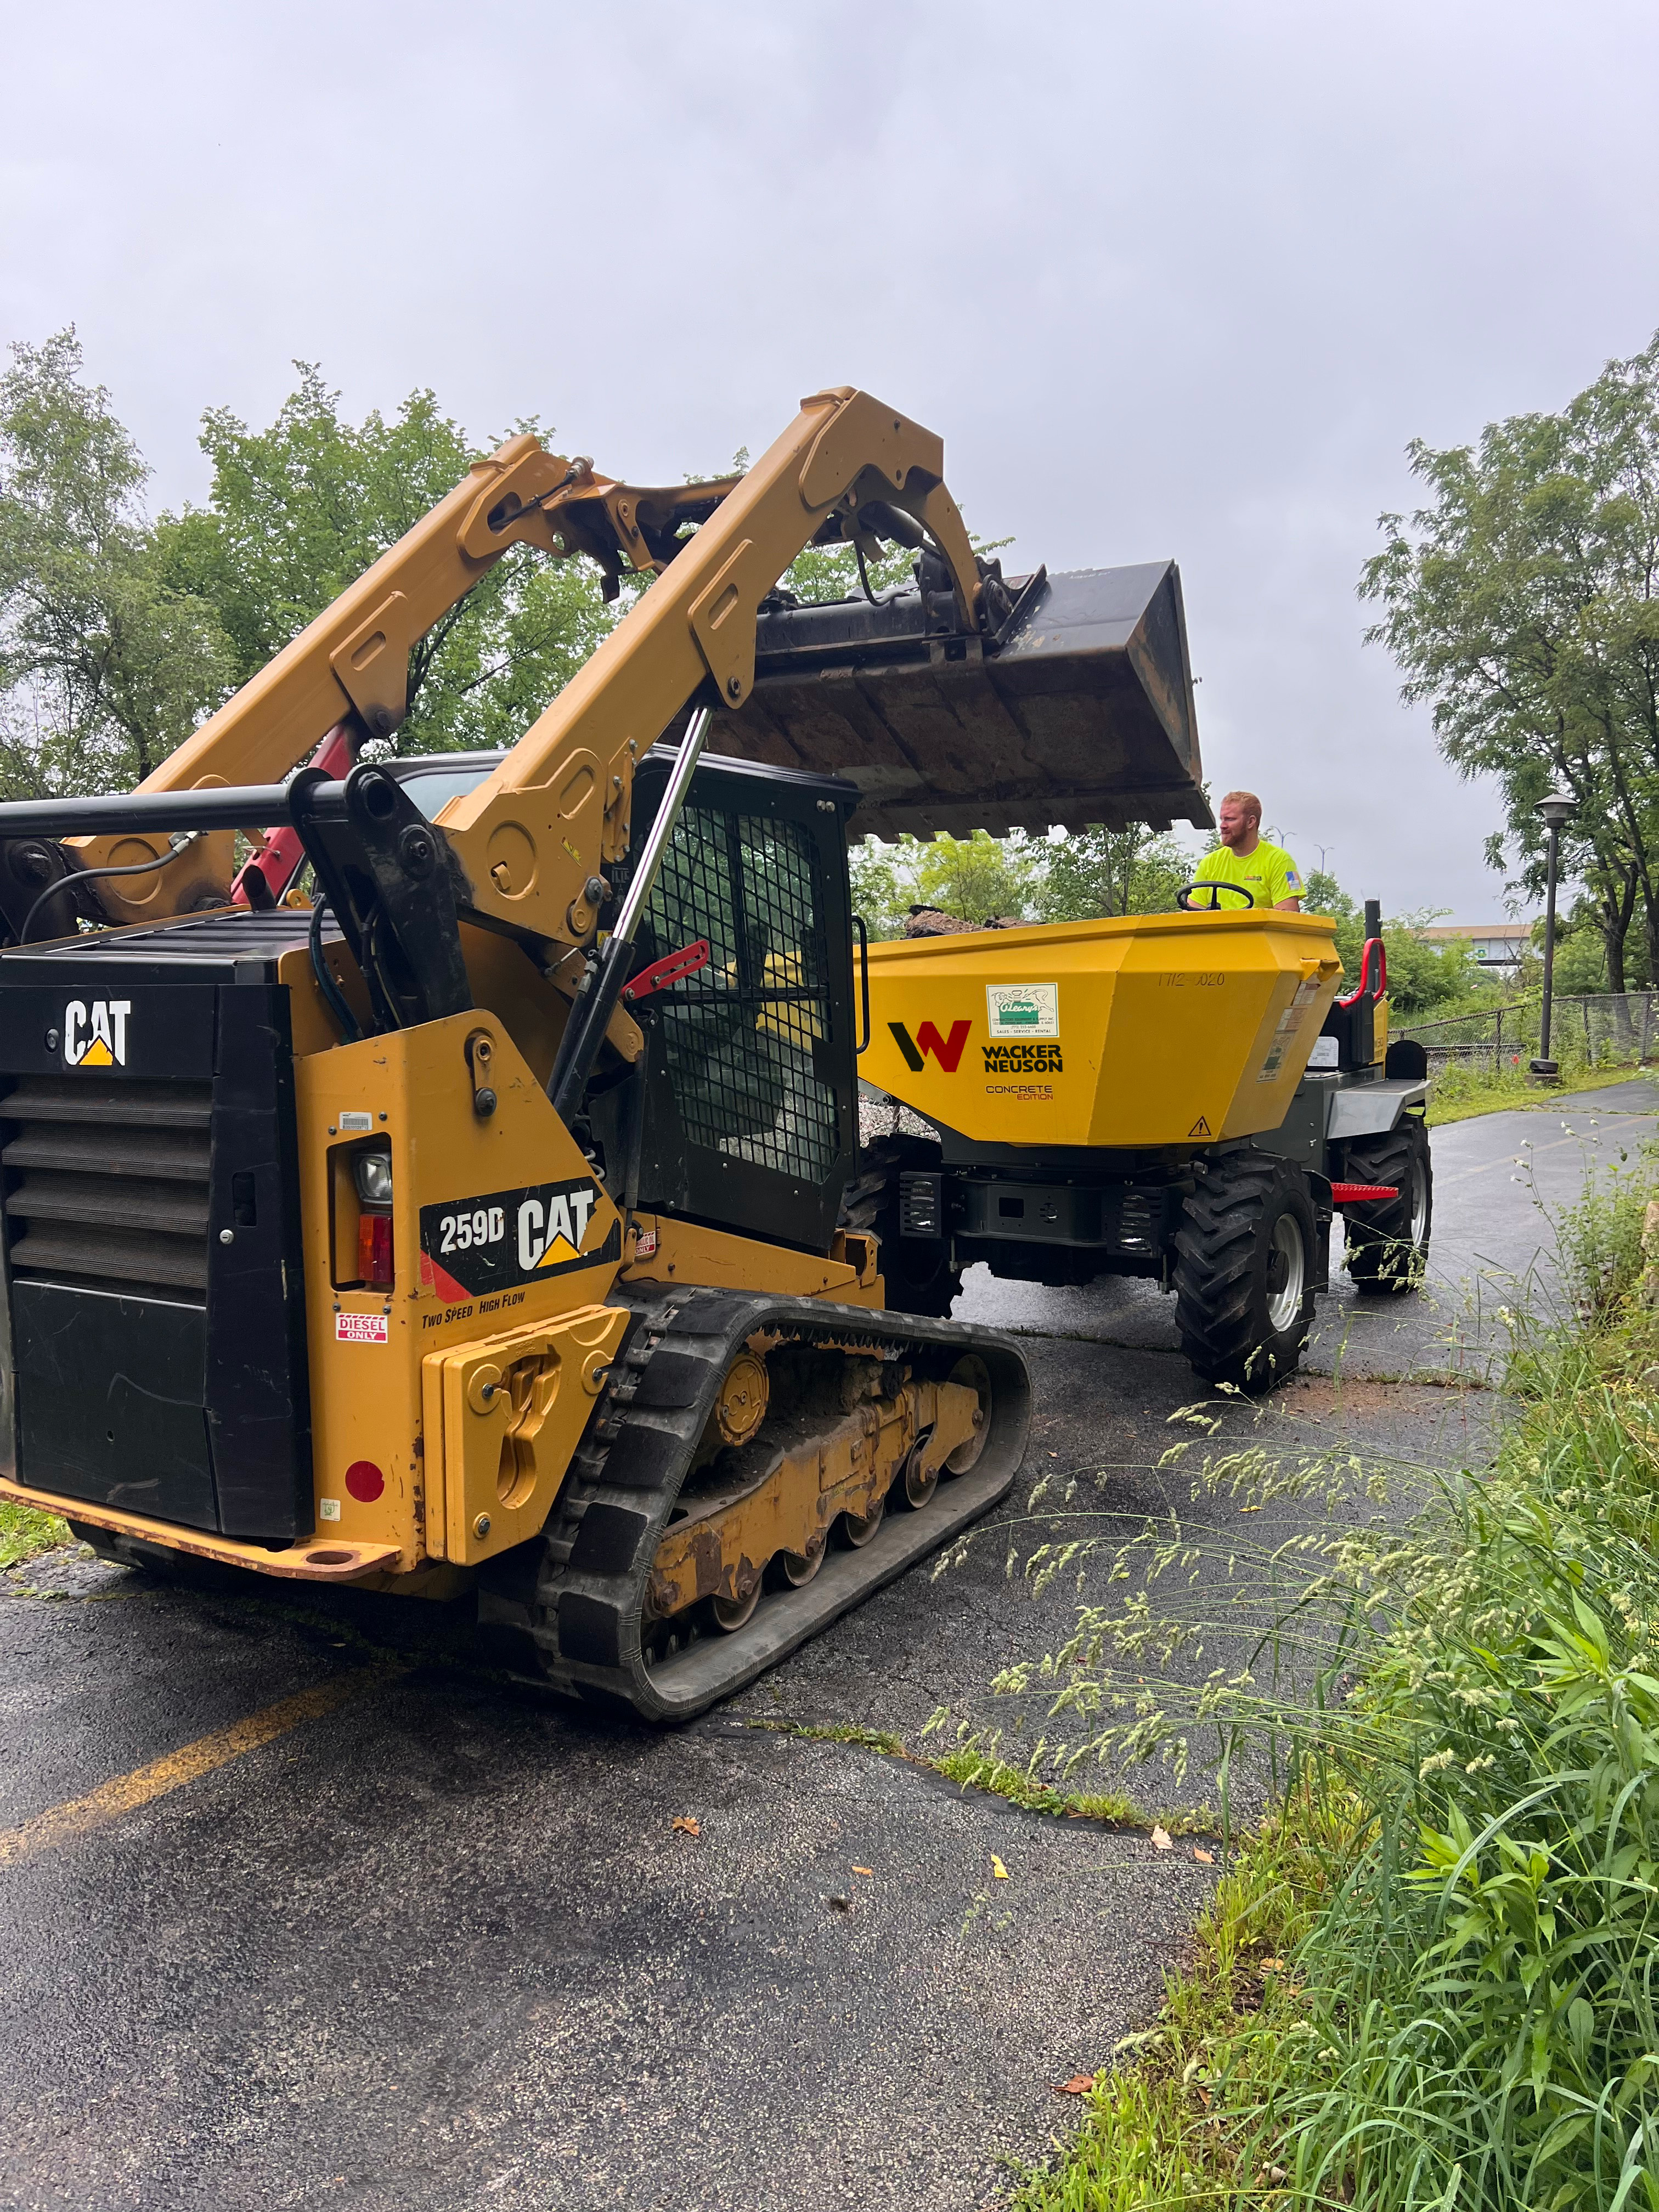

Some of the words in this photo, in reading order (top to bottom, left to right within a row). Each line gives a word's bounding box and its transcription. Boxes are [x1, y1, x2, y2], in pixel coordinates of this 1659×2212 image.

[1000, 1002, 1039, 1013] O'Leary's
[65, 1000, 131, 1066] CAT
[981, 1045, 1062, 1059] WACKER
[985, 1059, 1063, 1073] NEUSON
[986, 1085, 1052, 1093] CONCRETE
[440, 1207, 504, 1253] 259D
[518, 1189, 594, 1271] CAT
[635, 1246, 650, 1254] ONLY
[340, 1319, 385, 1330] DIESEL
